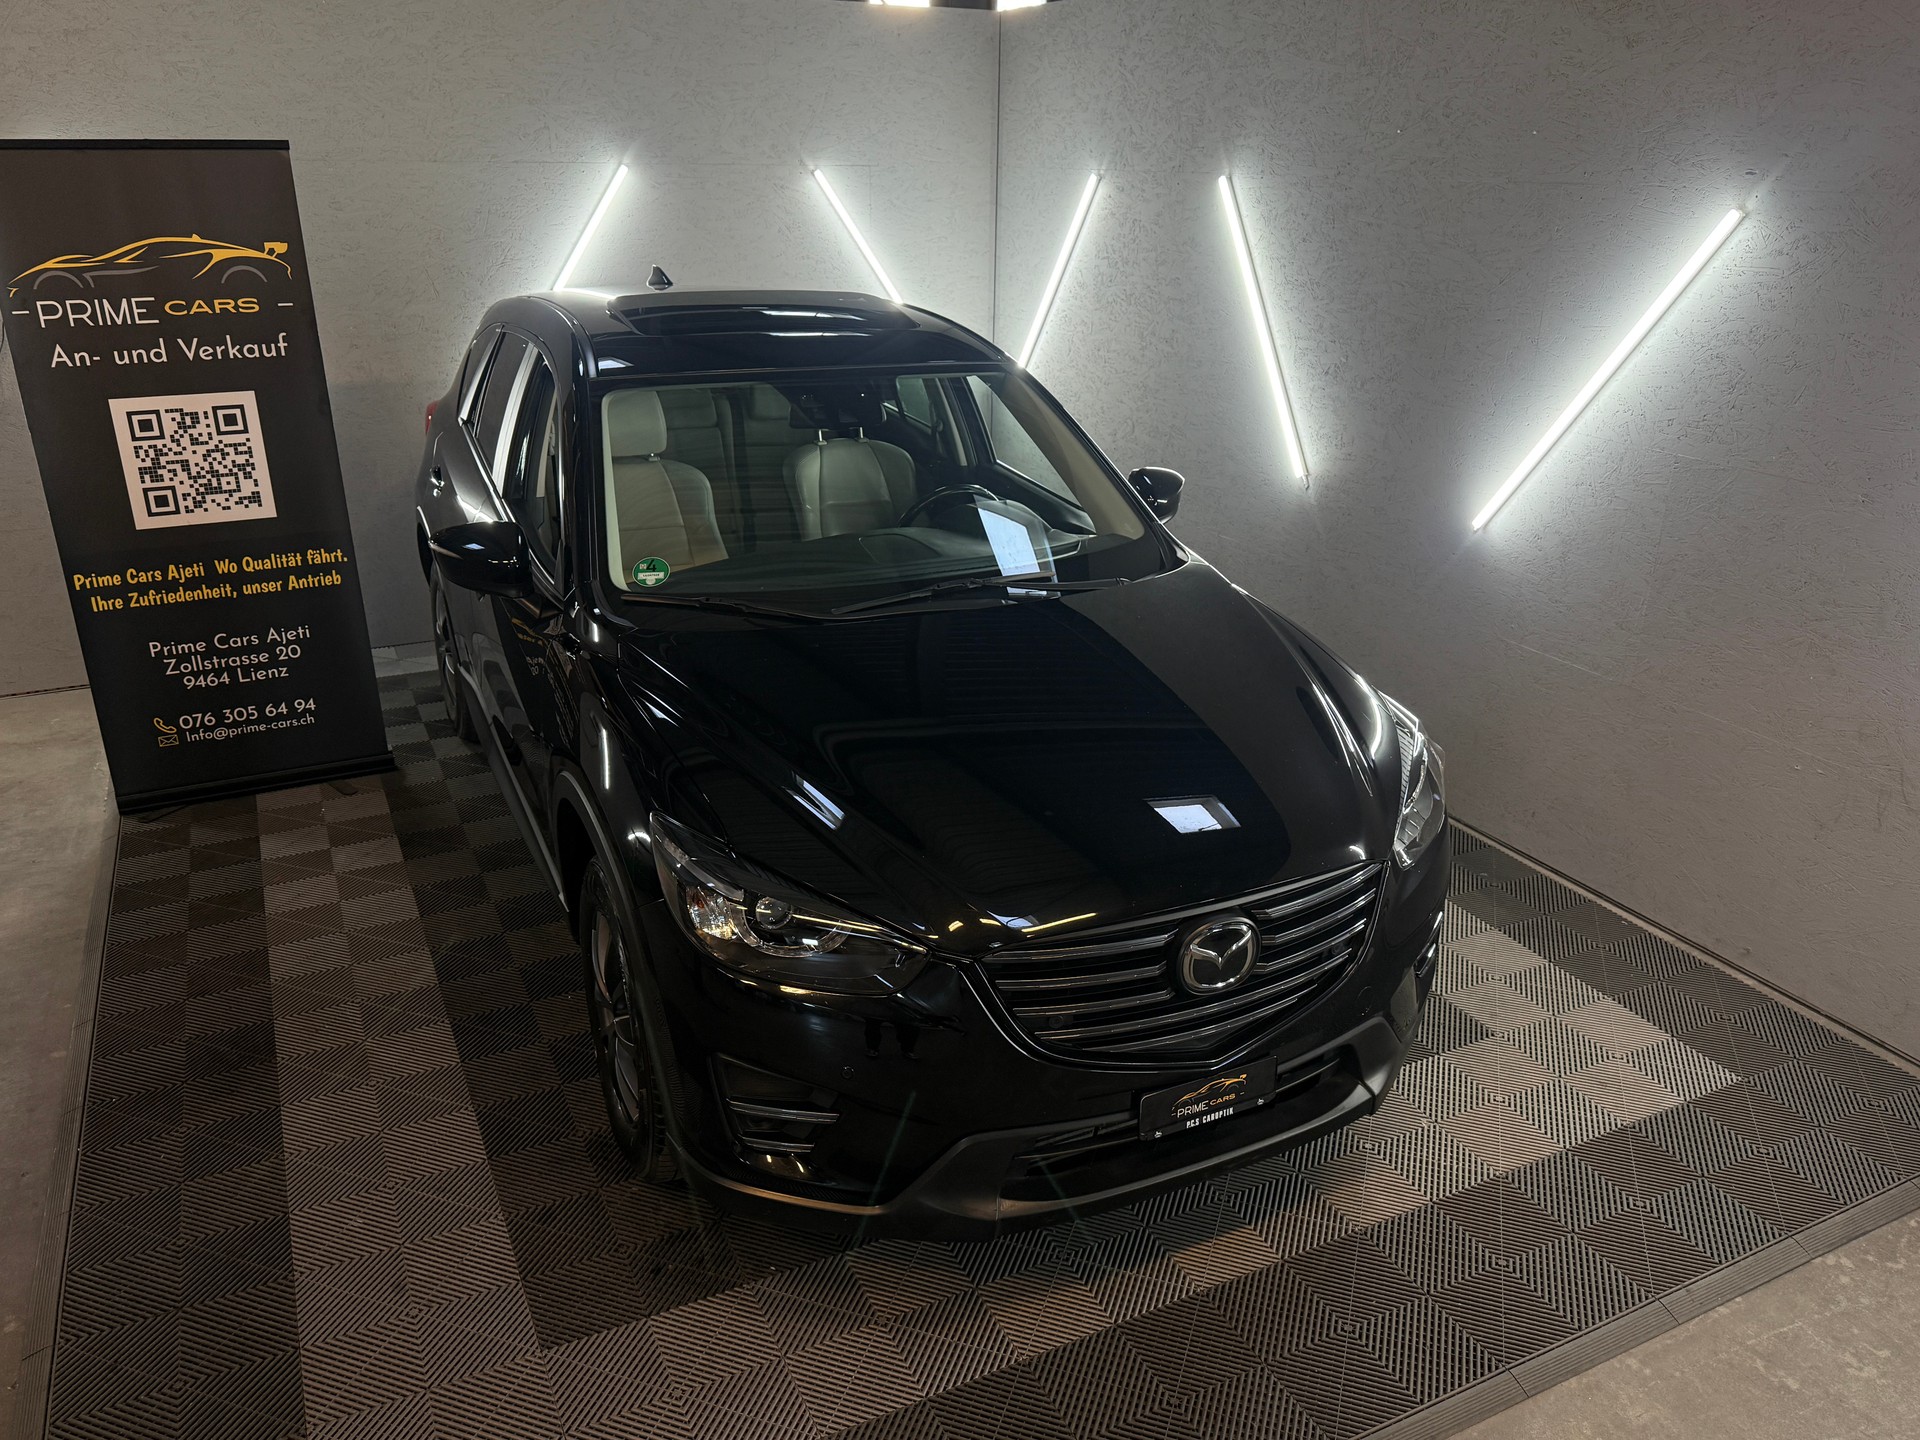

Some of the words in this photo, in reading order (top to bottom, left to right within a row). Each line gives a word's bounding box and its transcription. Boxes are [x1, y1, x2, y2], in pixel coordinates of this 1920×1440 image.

[35, 296, 160, 329] PRIME
[164, 296, 261, 316] CARS
[51, 343, 100, 368] An-
[114, 338, 167, 365] und
[177, 332, 289, 361] Verkauf
[73, 573, 122, 591] Prime
[126, 567, 163, 585] Cars
[167, 562, 205, 585] Ajeti
[215, 558, 238, 575] Wo
[242, 554, 302, 573] Qualität
[306, 549, 348, 565] fährt.
[646, 559, 657, 572] 4
[90, 595, 124, 613] Ihre
[129, 583, 238, 608] Zufriedenheit,
[242, 578, 283, 596] unser
[287, 570, 342, 590] Antrieb
[149, 640, 206, 657] Prime
[214, 632, 259, 650] Cars
[266, 625, 311, 646] Ajeti
[163, 651, 270, 675] Zollstrasse
[275, 644, 301, 661] 20
[183, 673, 230, 690] 9464
[237, 666, 290, 684] Lienz
[179, 713, 216, 730] 076
[223, 706, 258, 724] 305
[265, 702, 288, 717] 64
[294, 698, 316, 713] 94
[186, 713, 315, 743] Info@prime-cars.ch
[1177, 1100, 1209, 1118] PRIME
[1210, 1094, 1235, 1105] CARS
